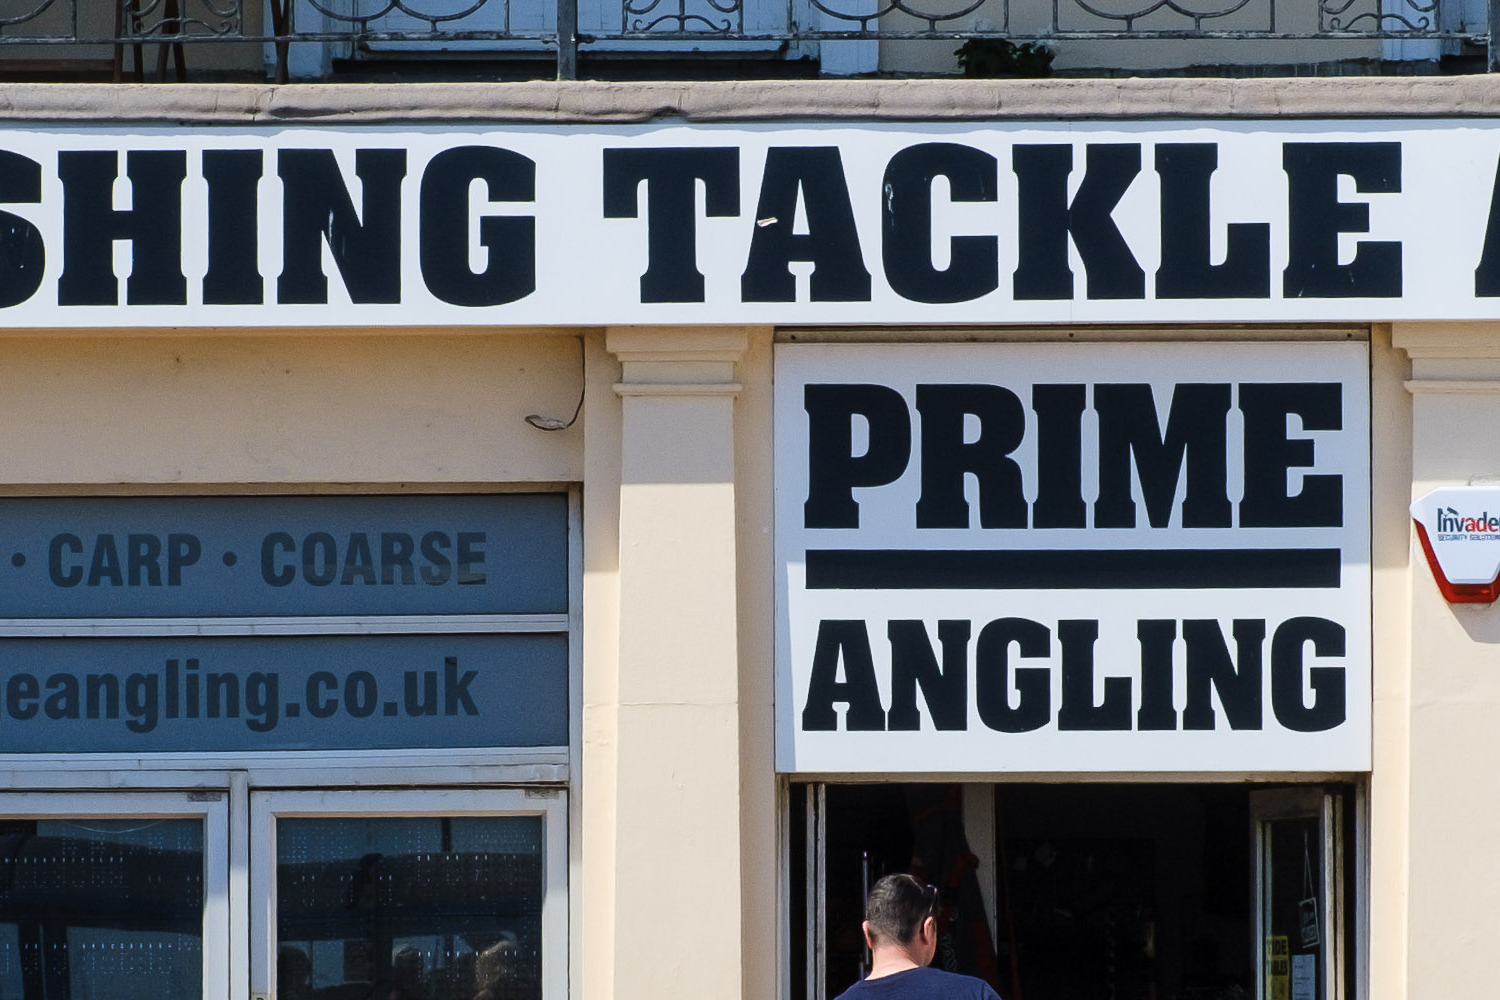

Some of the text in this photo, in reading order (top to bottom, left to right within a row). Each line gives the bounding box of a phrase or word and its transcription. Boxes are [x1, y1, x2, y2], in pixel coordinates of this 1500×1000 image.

[603, 141, 1403, 304] TACKLE
[804, 382, 1344, 530] PRIME
[48, 532, 202, 588] CARP
[260, 530, 487, 587] COARSE
[1437, 506, 1500, 533] Invade
[803, 616, 1346, 734] ANGLING
